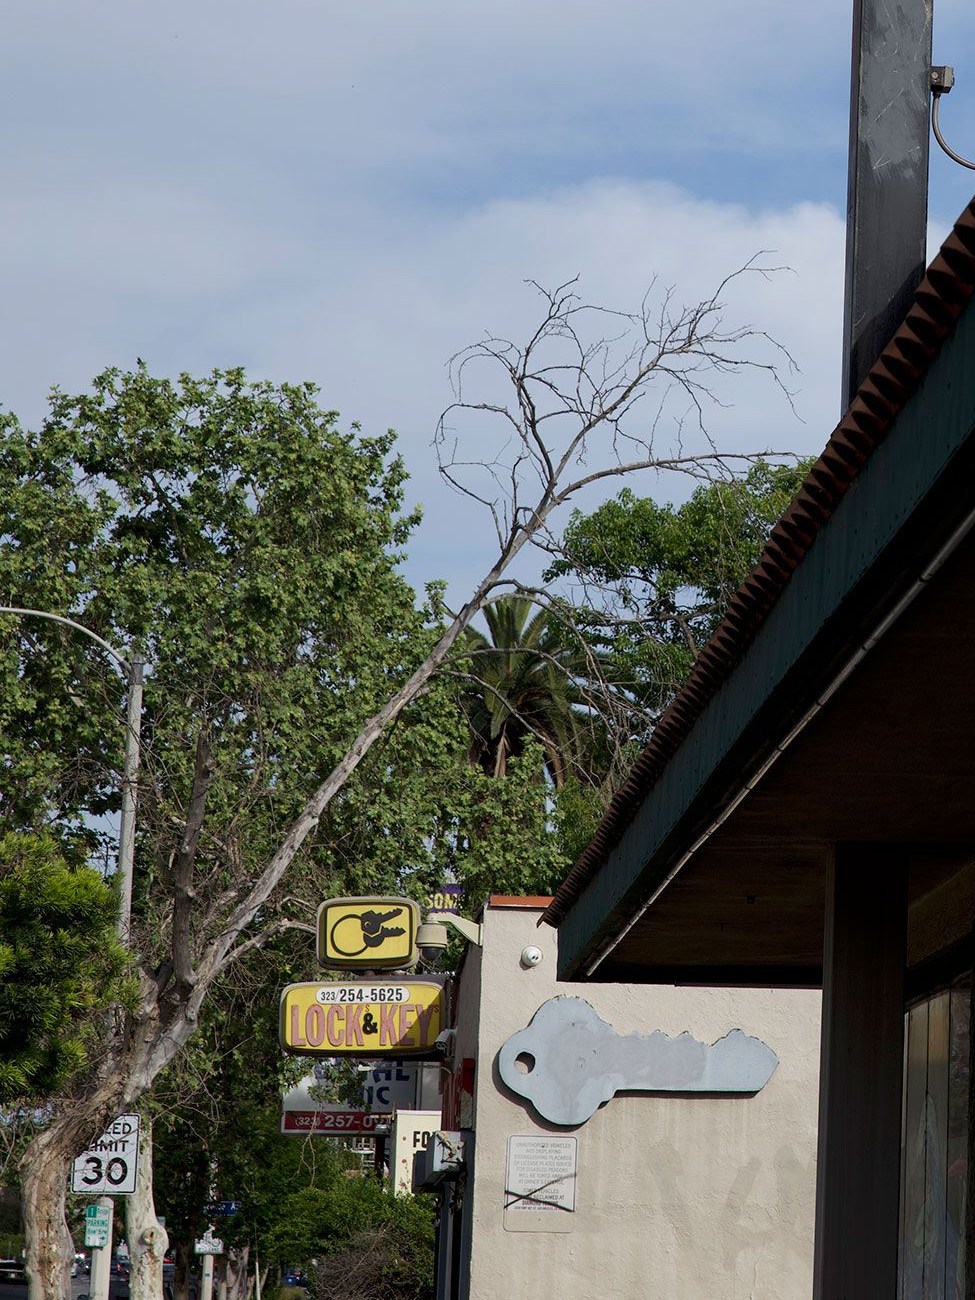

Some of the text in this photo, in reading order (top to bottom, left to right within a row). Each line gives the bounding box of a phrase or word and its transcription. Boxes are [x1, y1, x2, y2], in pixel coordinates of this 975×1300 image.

[362, 1012, 378, 1036] &
[324, 1114, 393, 1130] 257-0
[81, 1156, 128, 1186] 30
